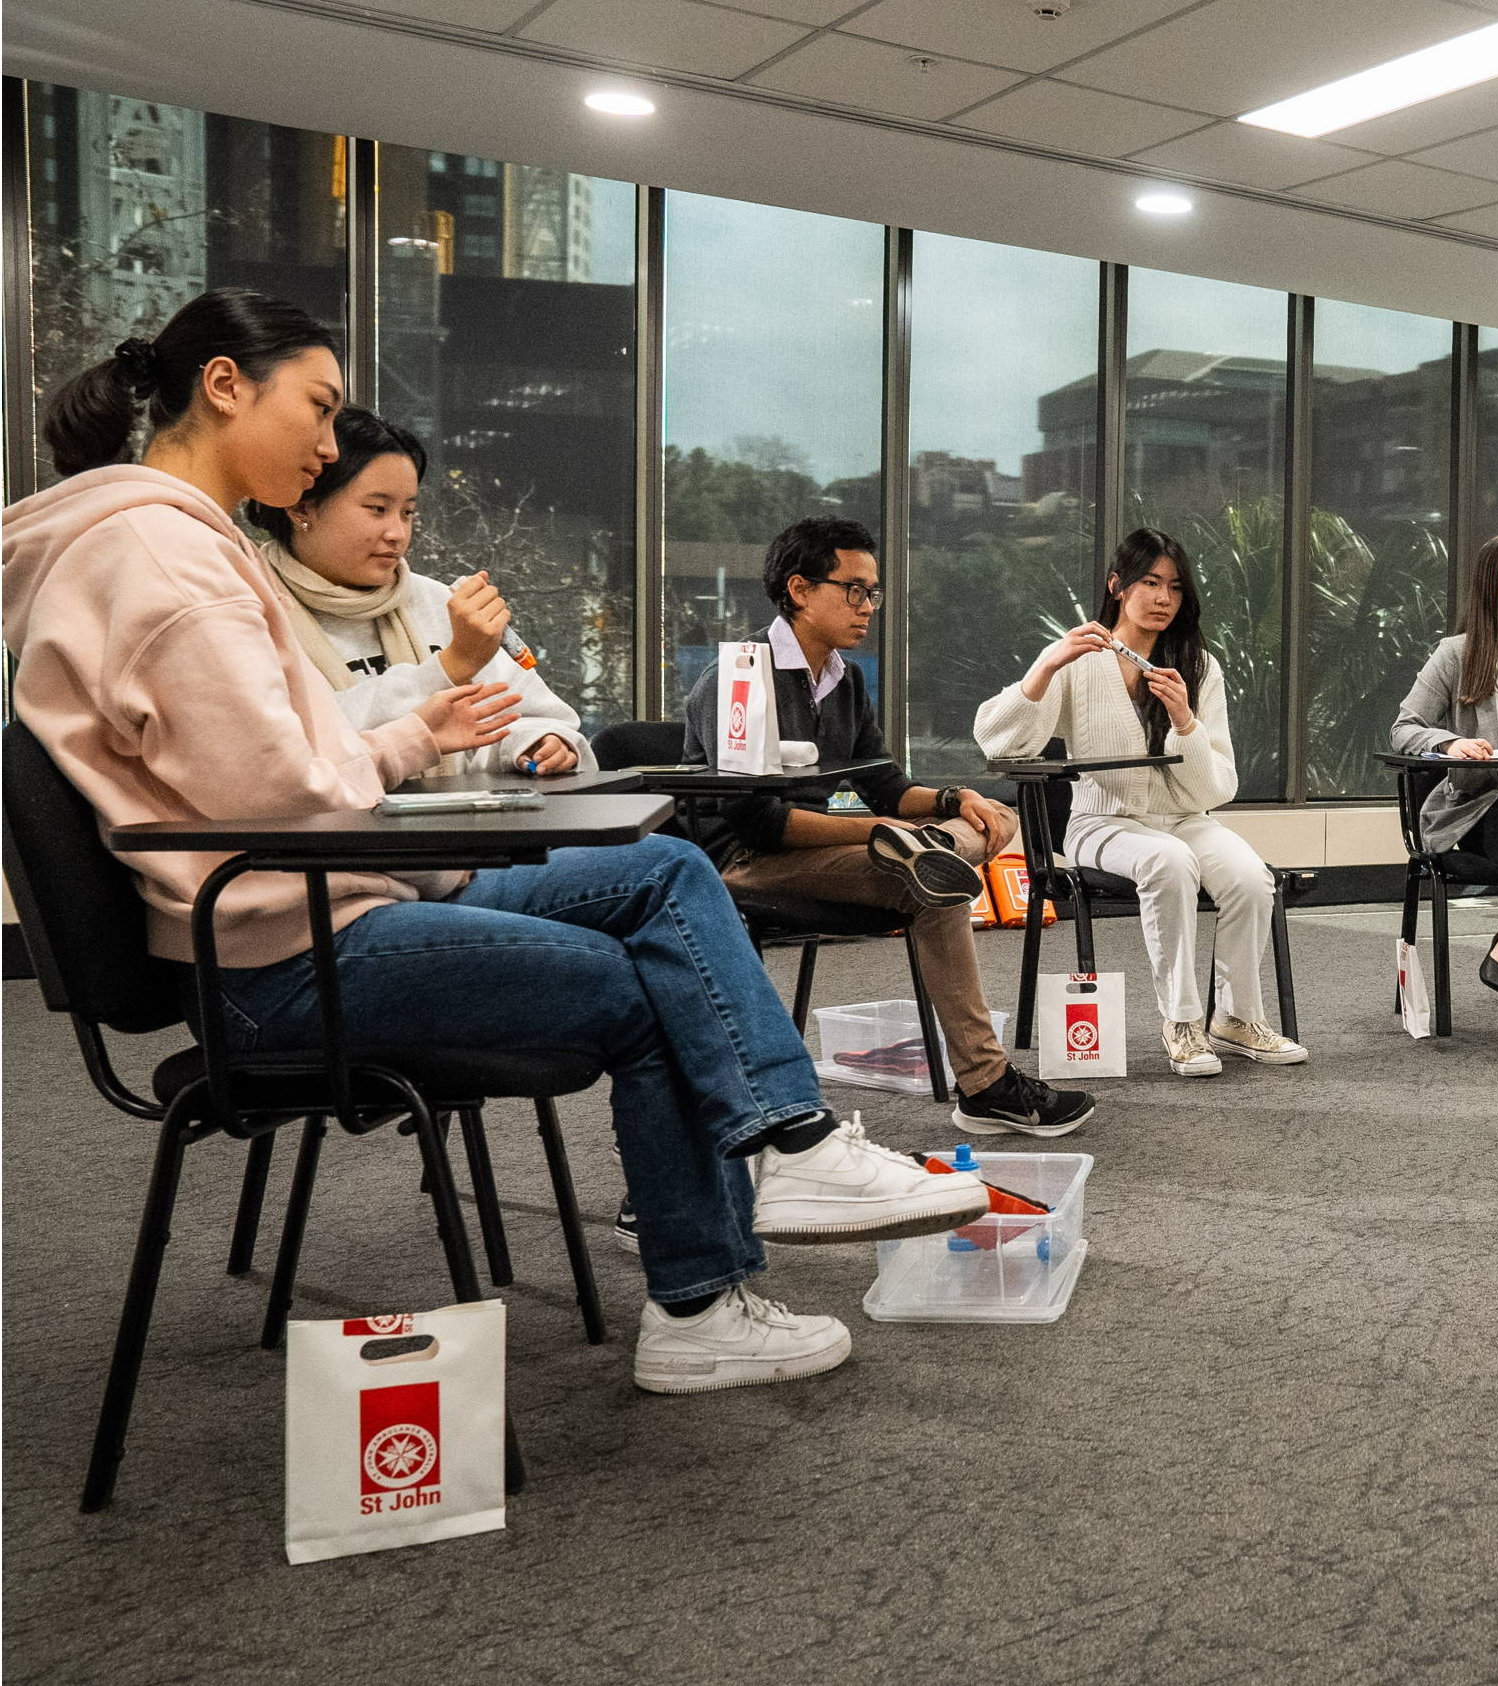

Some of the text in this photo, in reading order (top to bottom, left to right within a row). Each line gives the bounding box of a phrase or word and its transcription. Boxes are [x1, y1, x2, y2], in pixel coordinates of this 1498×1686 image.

[1067, 1050, 1100, 1061] St John
[373, 1426, 420, 1447] AMBULANCE
[360, 1488, 441, 1515] St John
